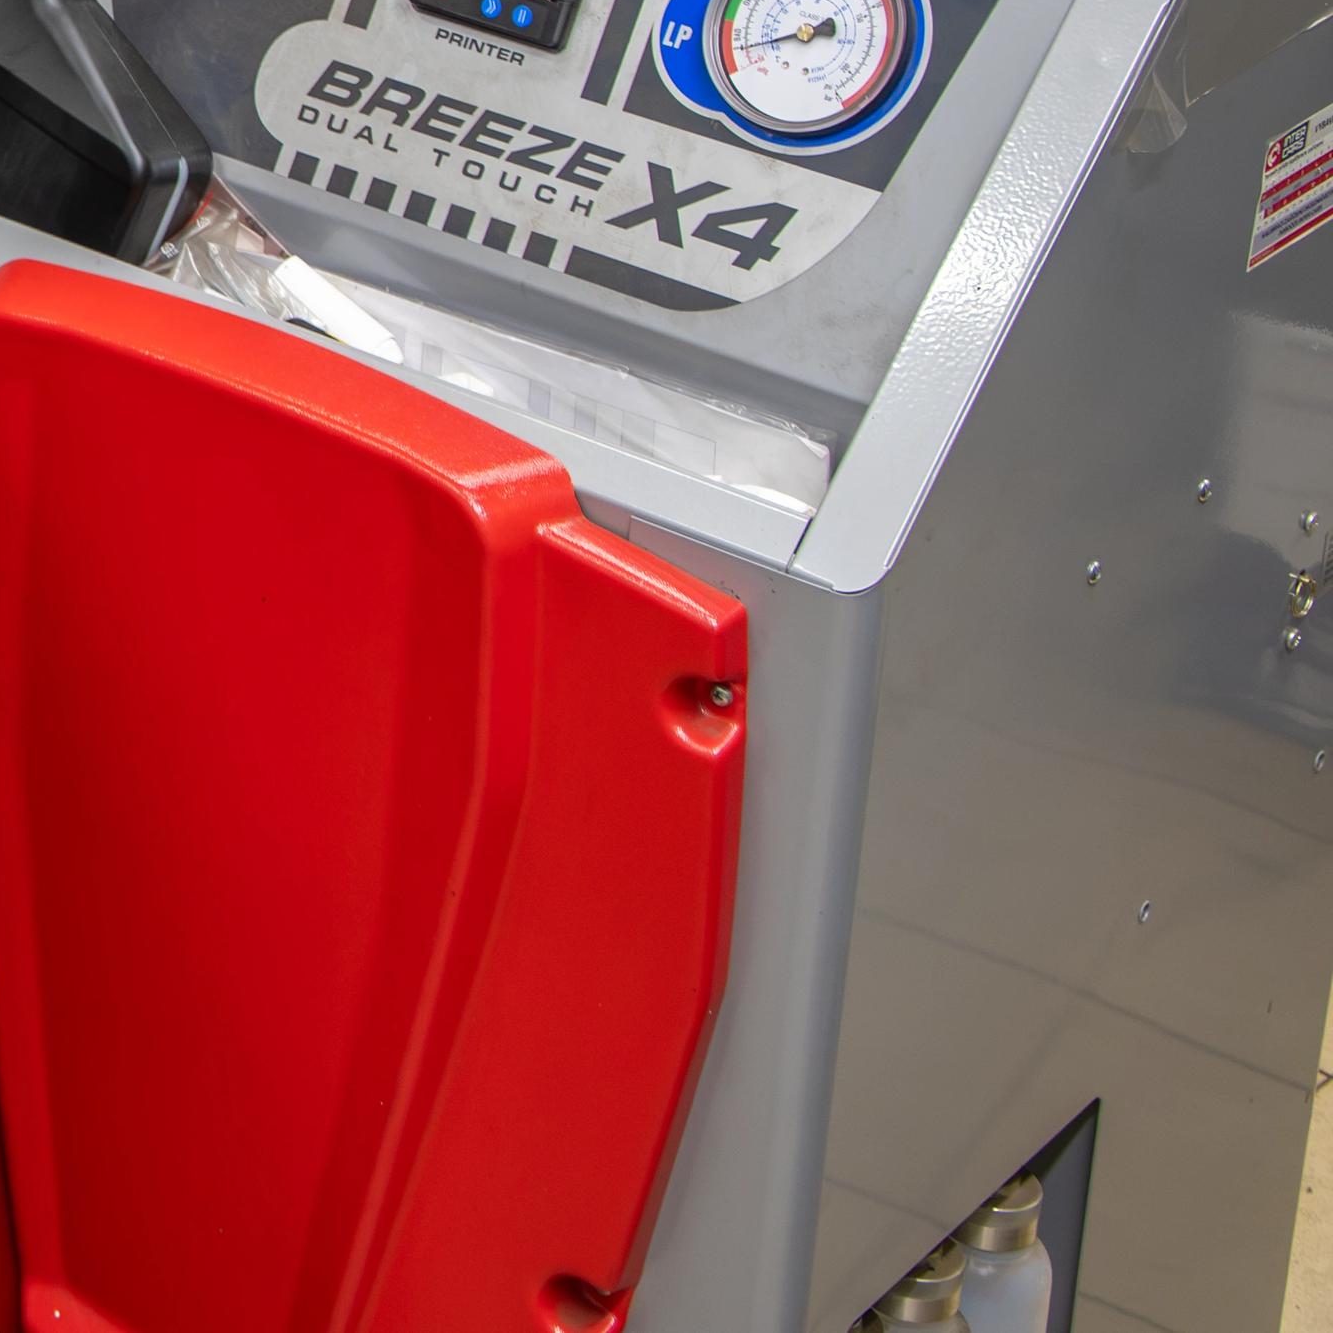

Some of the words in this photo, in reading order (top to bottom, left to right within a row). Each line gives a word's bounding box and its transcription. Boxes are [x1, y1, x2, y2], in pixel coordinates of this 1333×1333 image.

[435, 28, 526, 66] PRINTER
[662, 21, 693, 49] LP
[297, 104, 399, 153] DUAL
[433, 148, 595, 217] TOUCH
[307, 59, 626, 191] BREEZE
[604, 161, 798, 270] X4
